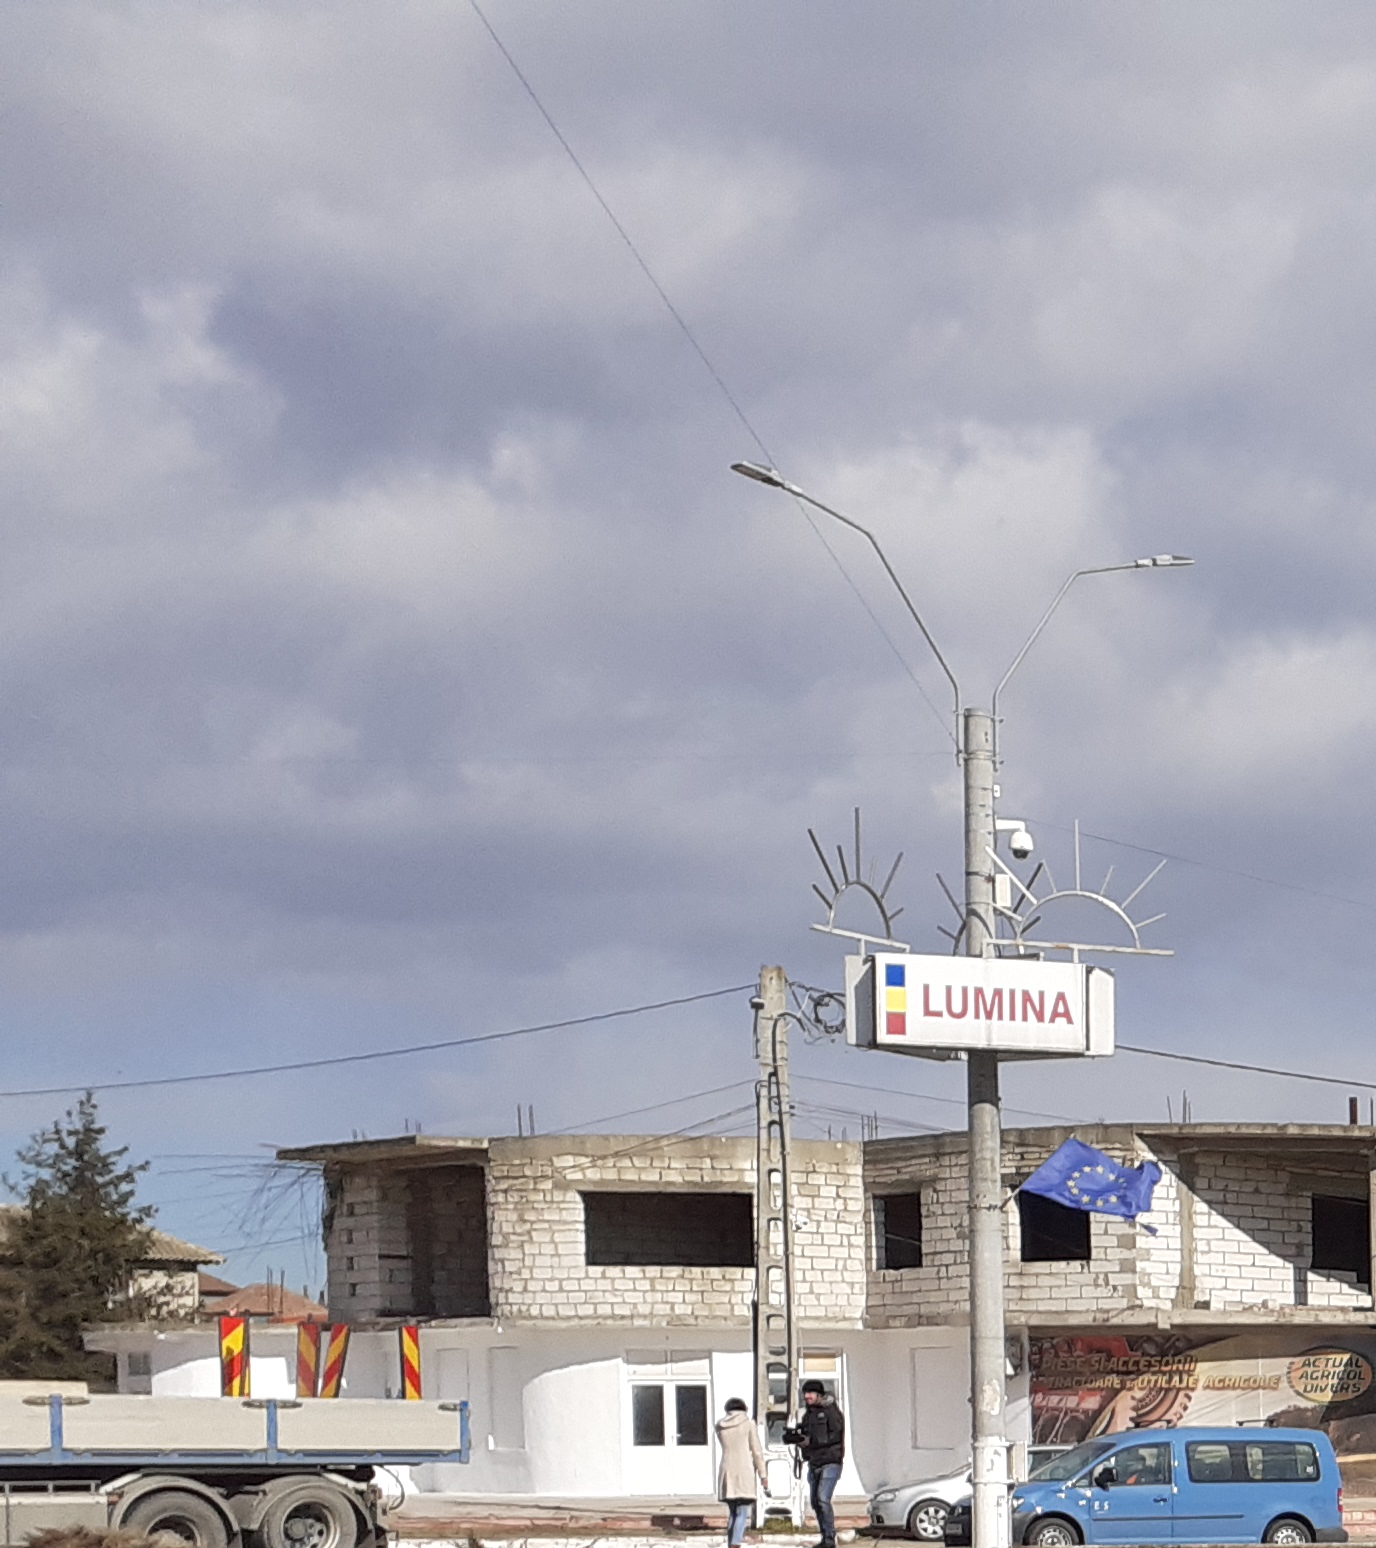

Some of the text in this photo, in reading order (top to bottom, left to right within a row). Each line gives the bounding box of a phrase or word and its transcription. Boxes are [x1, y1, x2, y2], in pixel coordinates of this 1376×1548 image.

[923, 983, 1075, 1025] LUMINA
[1107, 1354, 1199, 1372] ACCESORII
[1301, 1357, 1364, 1369] ACTUAL
[1137, 1374, 1199, 1390] UTILAJE
[1202, 1375, 1281, 1390] AGRICOLE
[1299, 1369, 1366, 1381] AGRICOL
[1303, 1382, 1361, 1394] DIVERS
